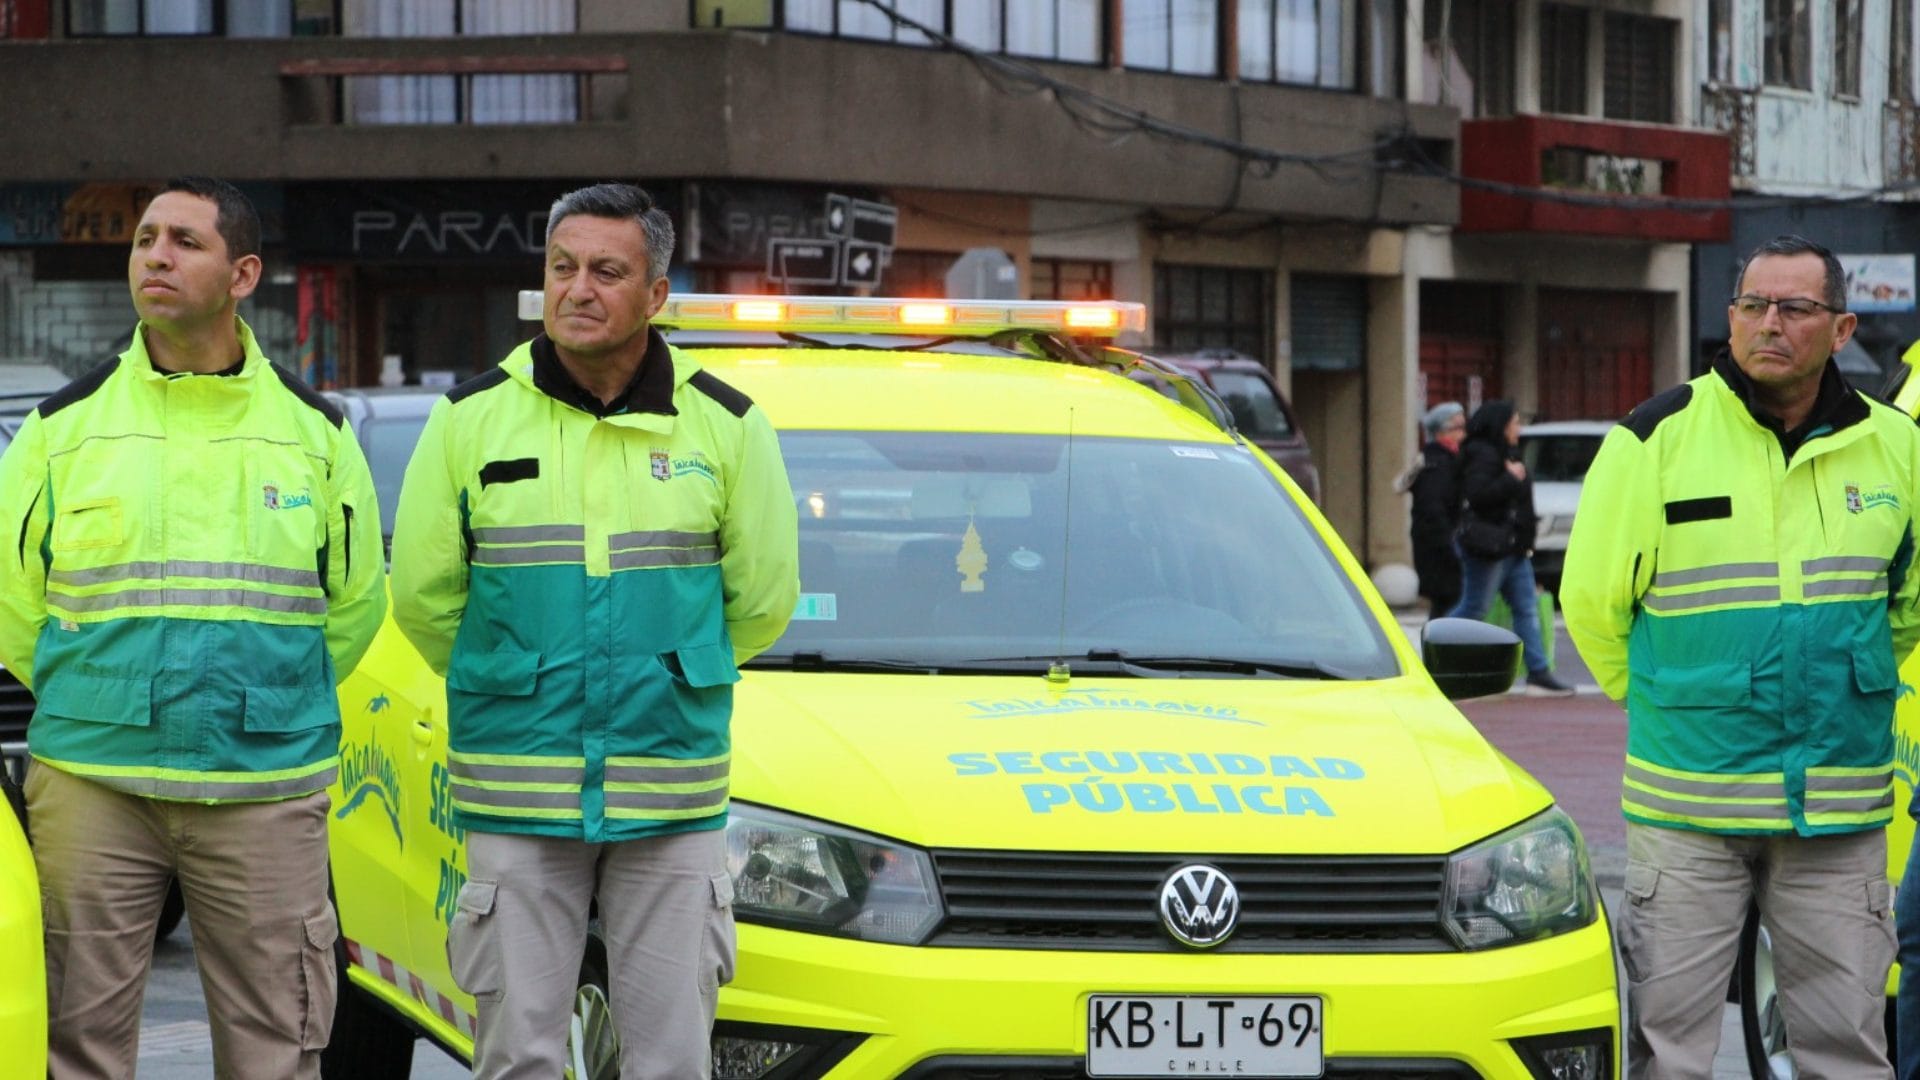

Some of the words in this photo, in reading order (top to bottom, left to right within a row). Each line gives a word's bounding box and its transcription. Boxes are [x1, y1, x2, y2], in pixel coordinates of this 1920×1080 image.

[965, 693, 1239, 717] Talcahuano
[947, 751, 1366, 780] SEGURIDAD
[1020, 776, 1337, 817] PÚBLICA
[1168, 1059, 1244, 1072] CHILE
